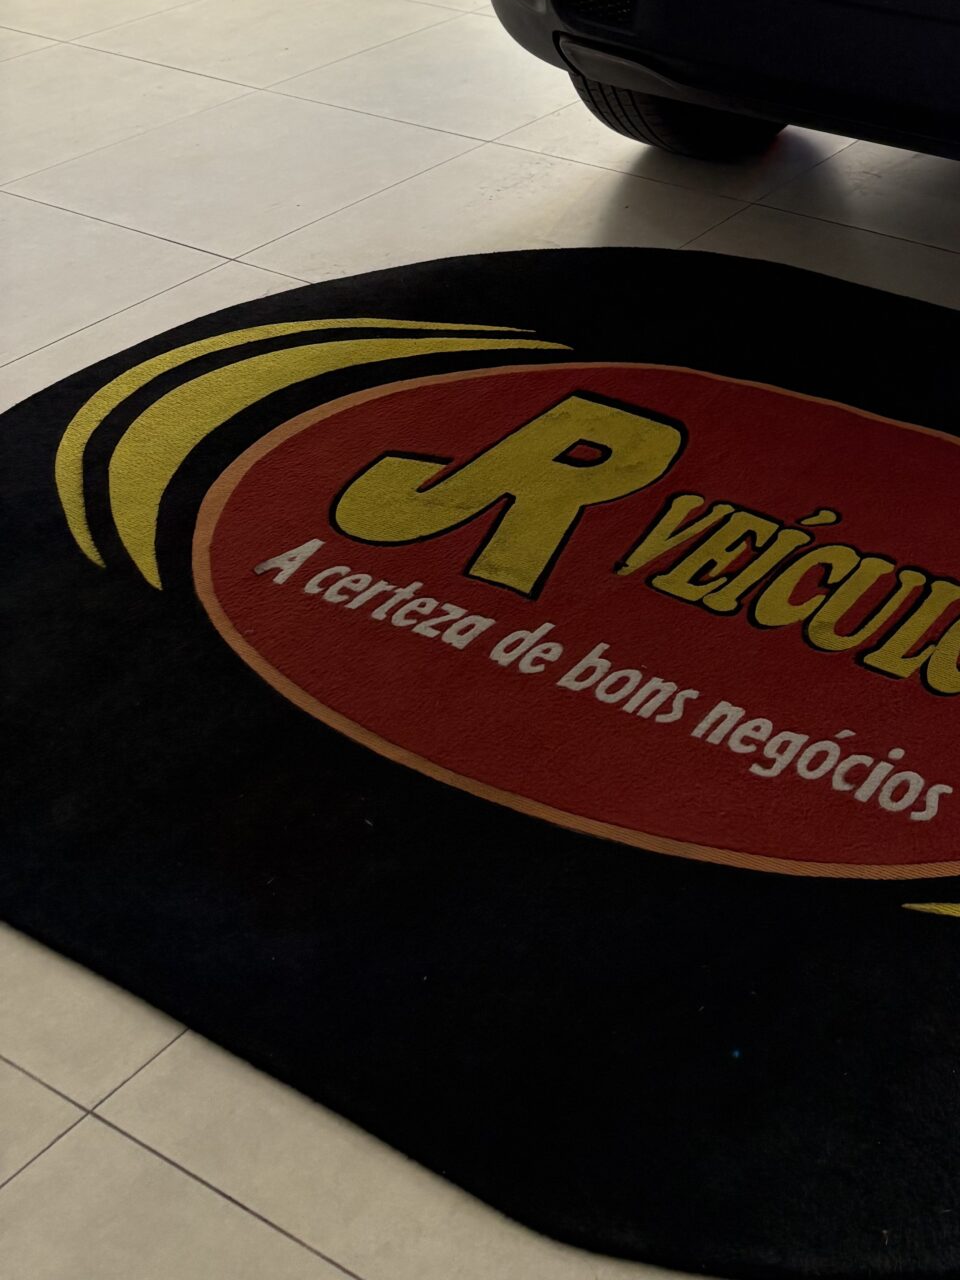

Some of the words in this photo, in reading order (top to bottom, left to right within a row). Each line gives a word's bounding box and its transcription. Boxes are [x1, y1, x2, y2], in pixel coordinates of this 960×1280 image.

[330, 392, 687, 598] JR
[254, 538, 326, 585] A
[303, 565, 496, 650] certeza
[489, 622, 564, 674] de
[556, 642, 701, 724] bons
[691, 699, 955, 822] negócios
